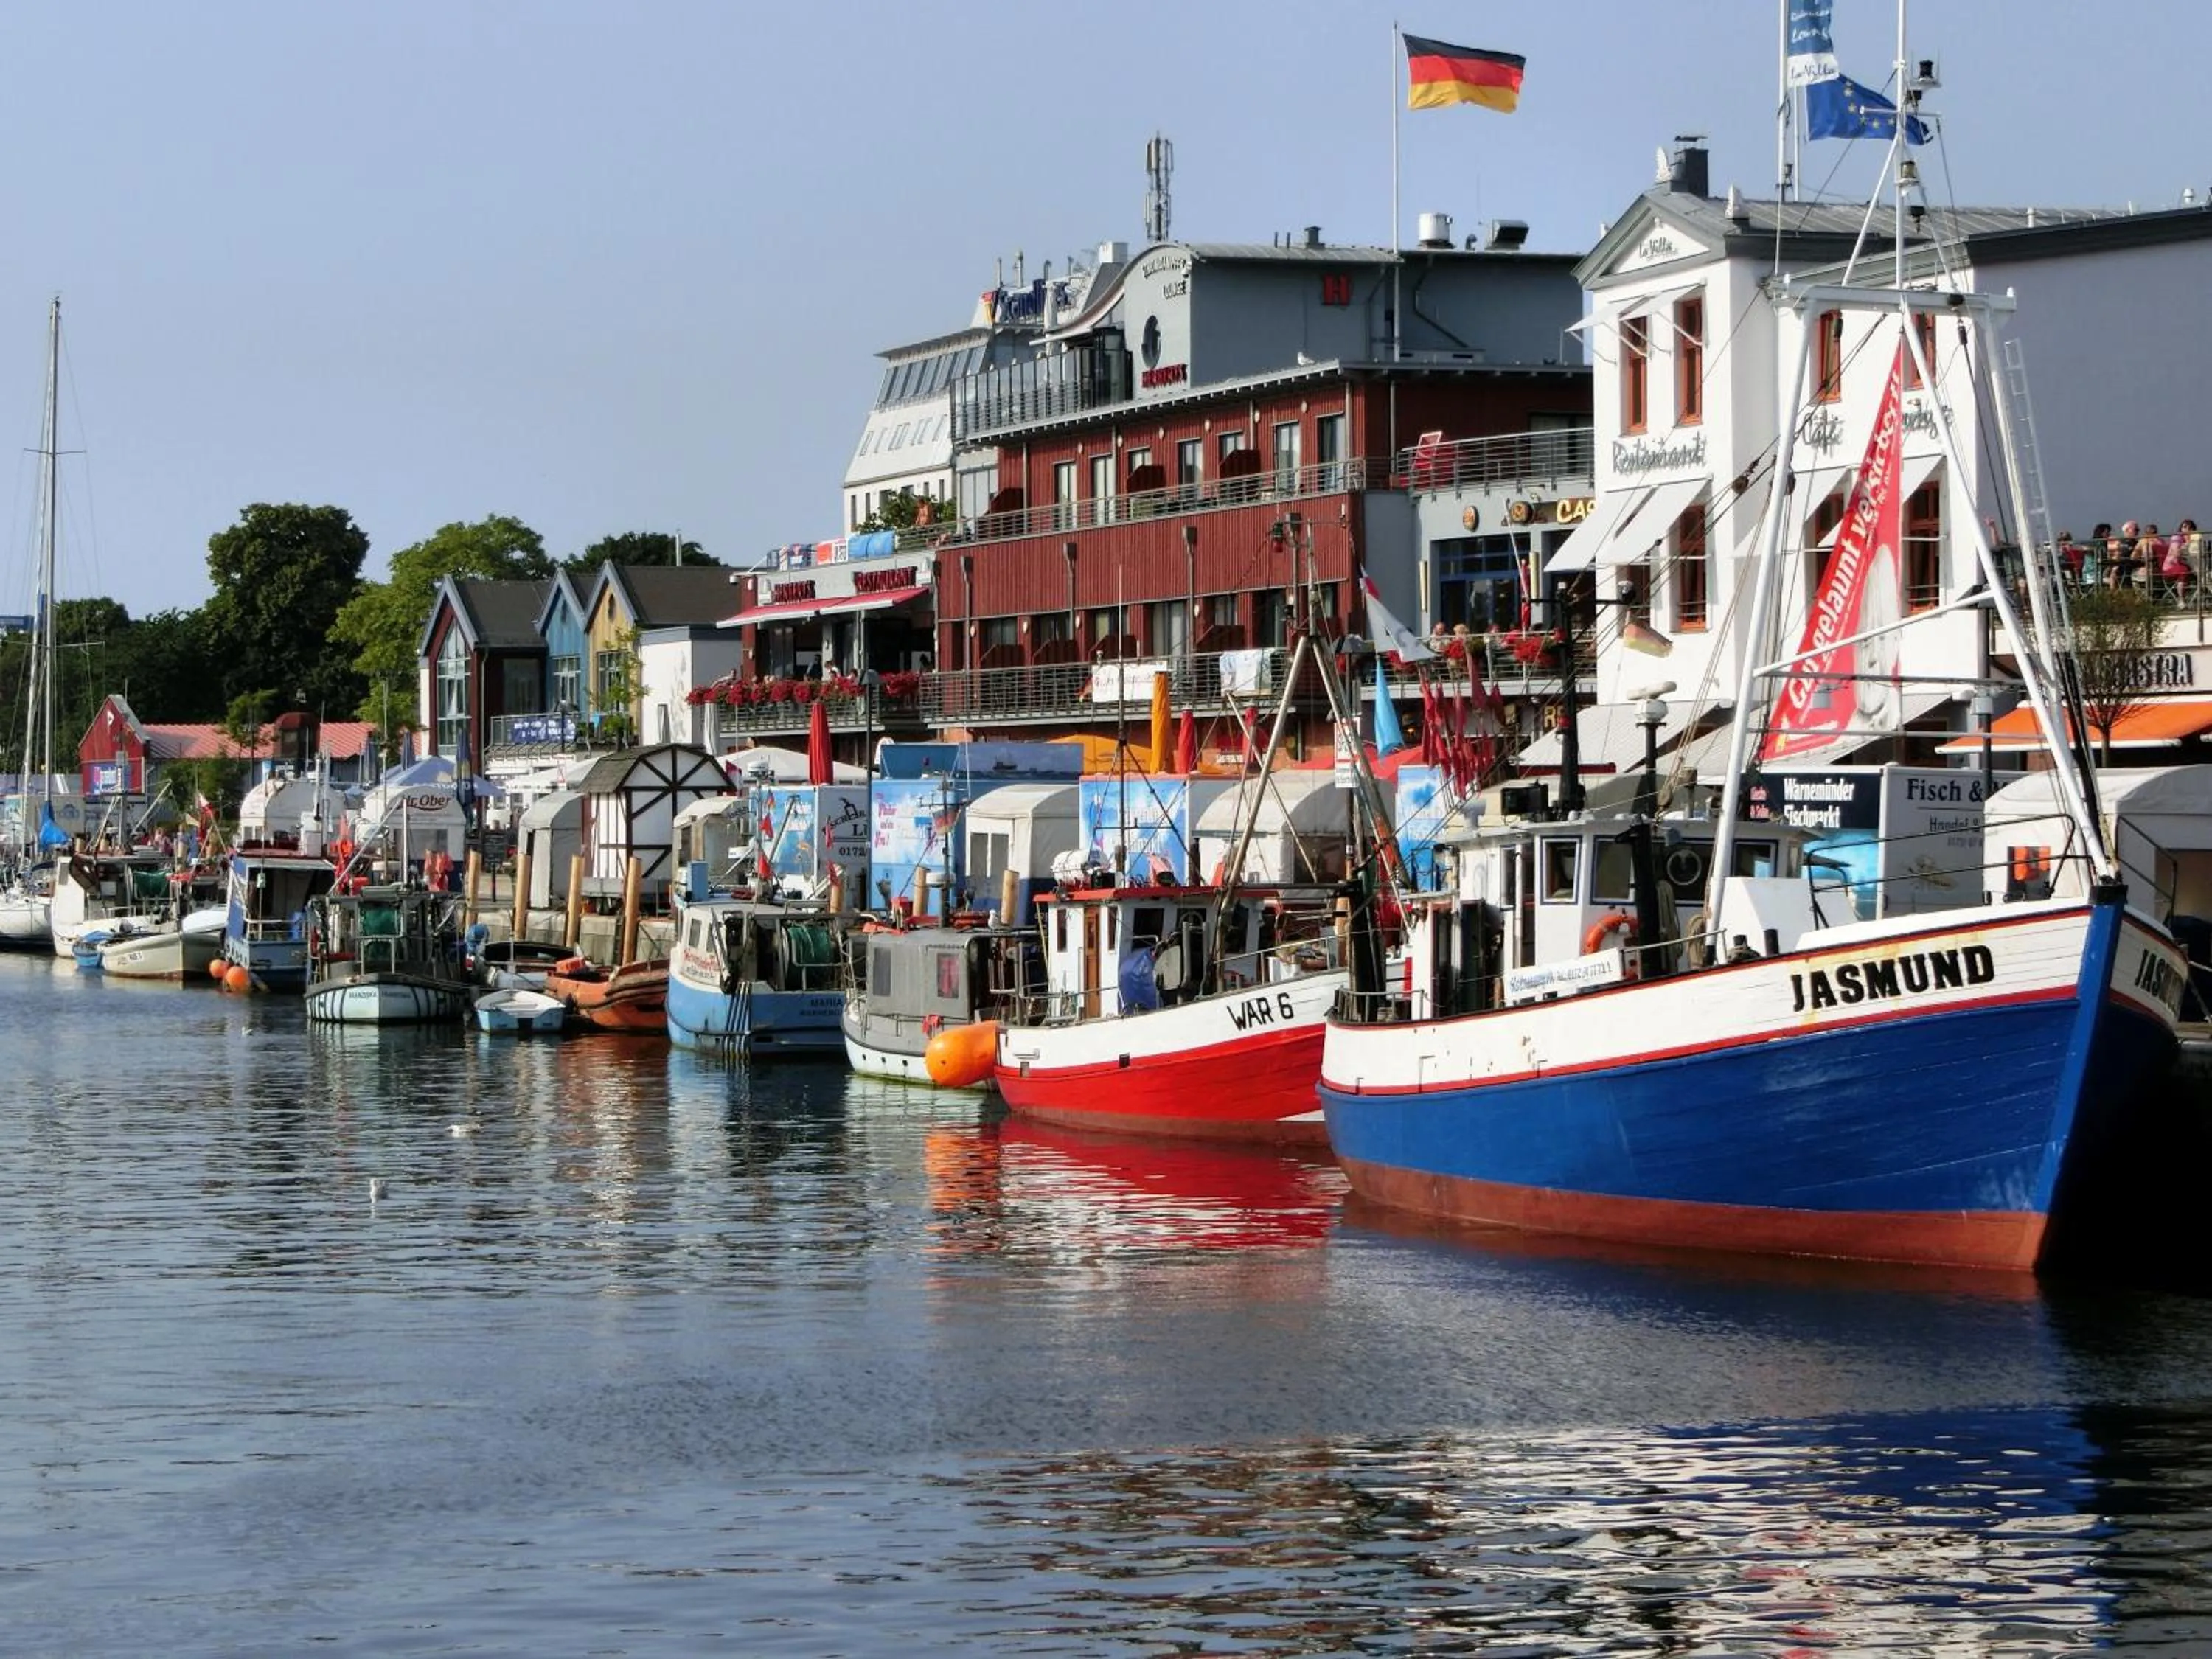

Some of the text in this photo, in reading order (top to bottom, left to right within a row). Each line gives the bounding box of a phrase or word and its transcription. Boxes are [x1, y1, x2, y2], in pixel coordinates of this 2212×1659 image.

[1612, 431, 1707, 476] Restaurant
[1783, 777, 1855, 801] Warnemünder
[1906, 779, 1961, 802] Fisch
[1969, 779, 1983, 802] &
[1790, 945, 1995, 1012] JASMUND
[1226, 992, 1295, 1031] WAR 6
